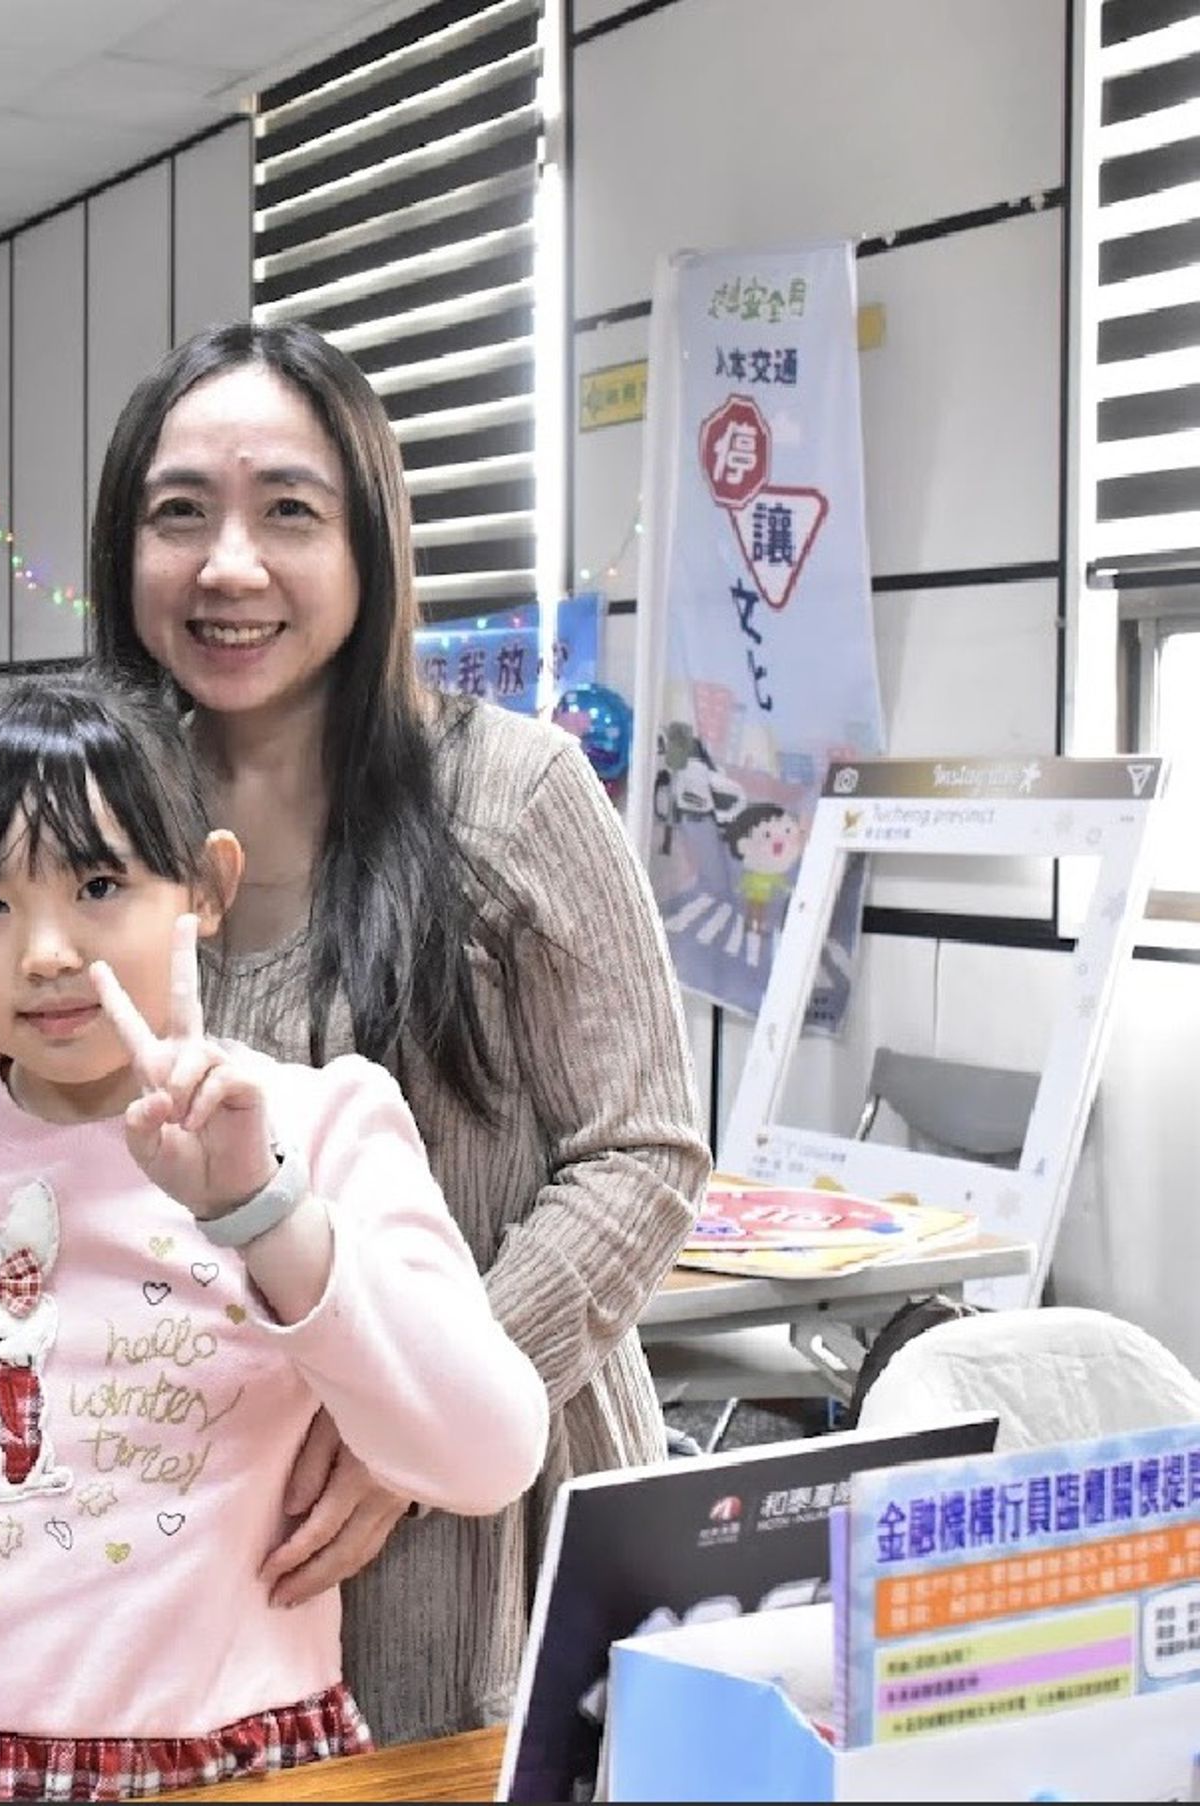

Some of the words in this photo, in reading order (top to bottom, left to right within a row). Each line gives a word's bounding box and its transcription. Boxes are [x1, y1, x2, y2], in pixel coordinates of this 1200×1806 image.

[714, 345, 798, 386] 人本交通
[712, 420, 758, 484] 停
[752, 502, 794, 568] 讓
[104, 1315, 218, 1367] hello
